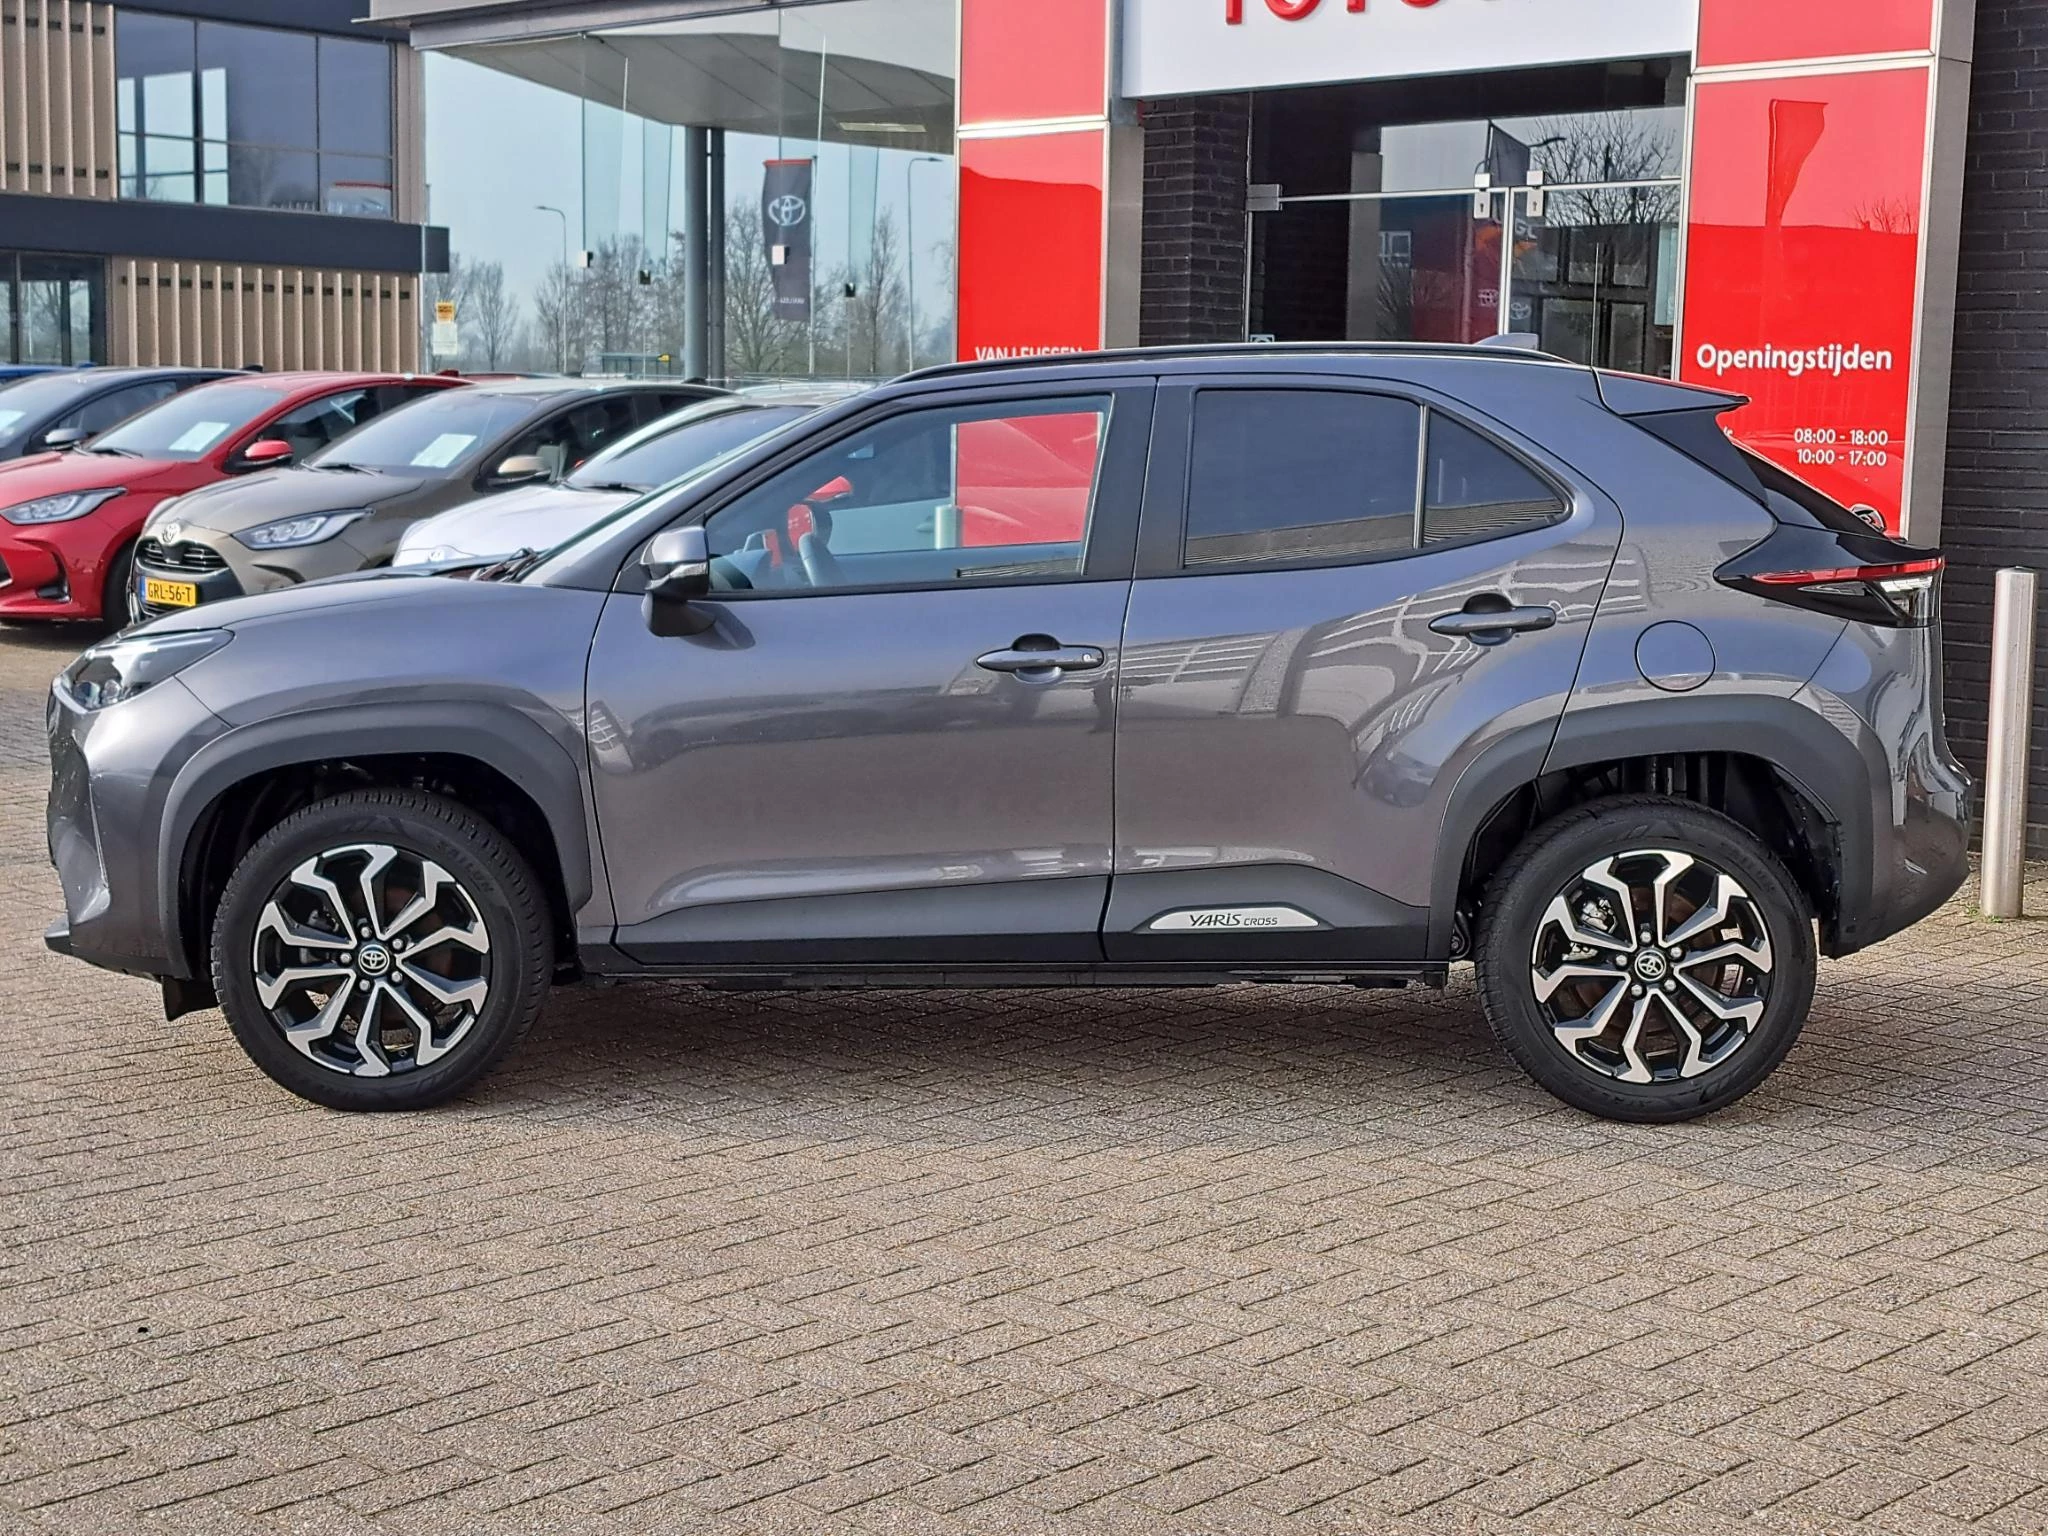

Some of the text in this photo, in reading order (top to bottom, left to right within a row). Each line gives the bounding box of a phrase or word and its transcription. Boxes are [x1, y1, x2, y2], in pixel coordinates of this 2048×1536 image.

[975, 346, 1009, 361] VAN
[1696, 343, 1893, 377] Openingstijden
[1794, 428, 1836, 444] 08:00
[1849, 429, 1889, 445] 18:00
[1797, 449, 1836, 464] 10:00
[1849, 451, 1888, 467] 17:00
[147, 582, 192, 603] GRL-56-T
[1189, 913, 1278, 927] YARIS CROSS
